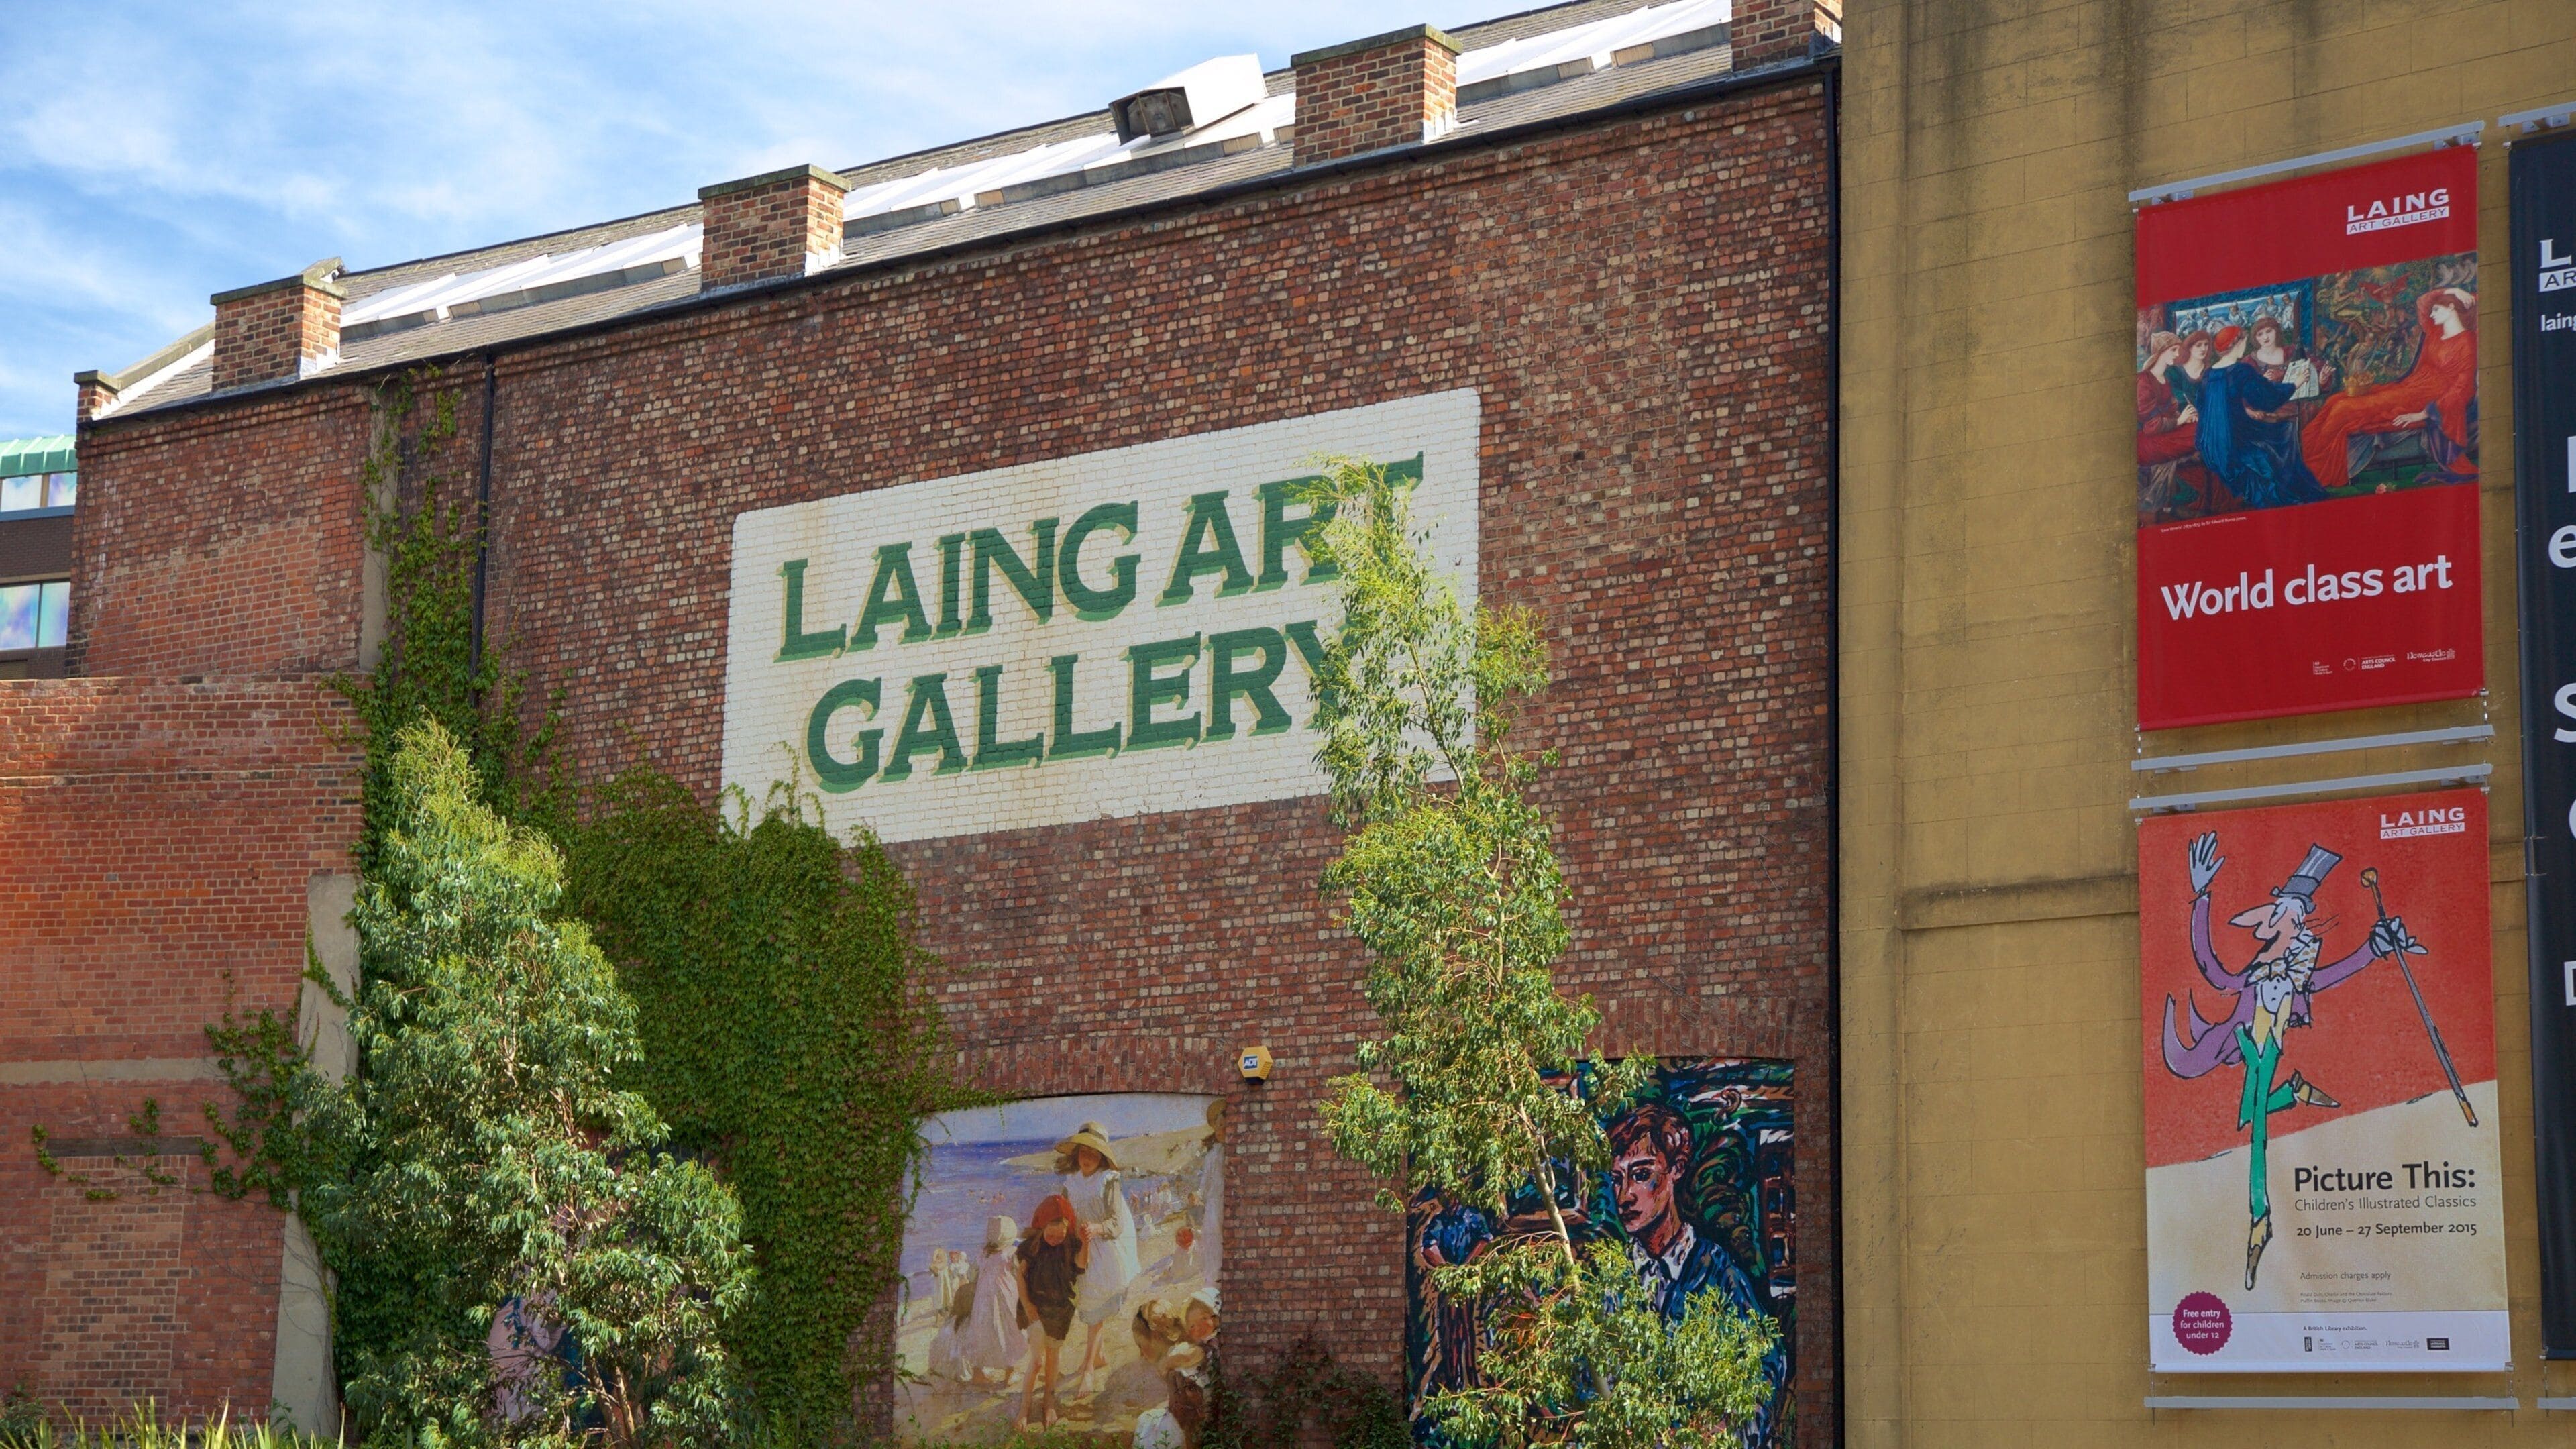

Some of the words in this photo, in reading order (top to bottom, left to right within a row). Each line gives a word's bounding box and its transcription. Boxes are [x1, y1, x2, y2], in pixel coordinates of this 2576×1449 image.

[2347, 188, 2450, 222] LAING
[2349, 221, 2376, 233] ART
[2381, 207, 2446, 227] GALLERY
[773, 500, 1142, 662] LAING
[2161, 568, 2274, 620] World
[2284, 564, 2383, 605] class
[2393, 555, 2453, 594] art
[804, 609, 1379, 796] GALLERY
[2381, 807, 2465, 828] LAING
[2383, 828, 2405, 837] ART
[2410, 823, 2463, 835] GALLERY
[1244, 1058, 1258, 1066] ADT
[2294, 1165, 2393, 1192] Picture
[2402, 1161, 2475, 1189] This:
[2294, 1197, 2354, 1211] Children's
[2359, 1195, 2420, 1209] Illustrated
[2425, 1195, 2477, 1208] Classics
[2297, 1227, 2312, 1236] 20
[2316, 1224, 2343, 1238] June
[2358, 1226, 2371, 1237] 27
[2375, 1221, 2444, 1237] September
[2448, 1223, 2477, 1236] 2015
[2341, 1271, 2369, 1281] charges
[2371, 1271, 2391, 1280] apply
[2183, 1309, 2199, 1318] Free
[2200, 1309, 2221, 1320] entry
[2180, 1320, 2191, 1329] for
[2192, 1320, 2224, 1329] children
[2186, 1330, 2208, 1339] under
